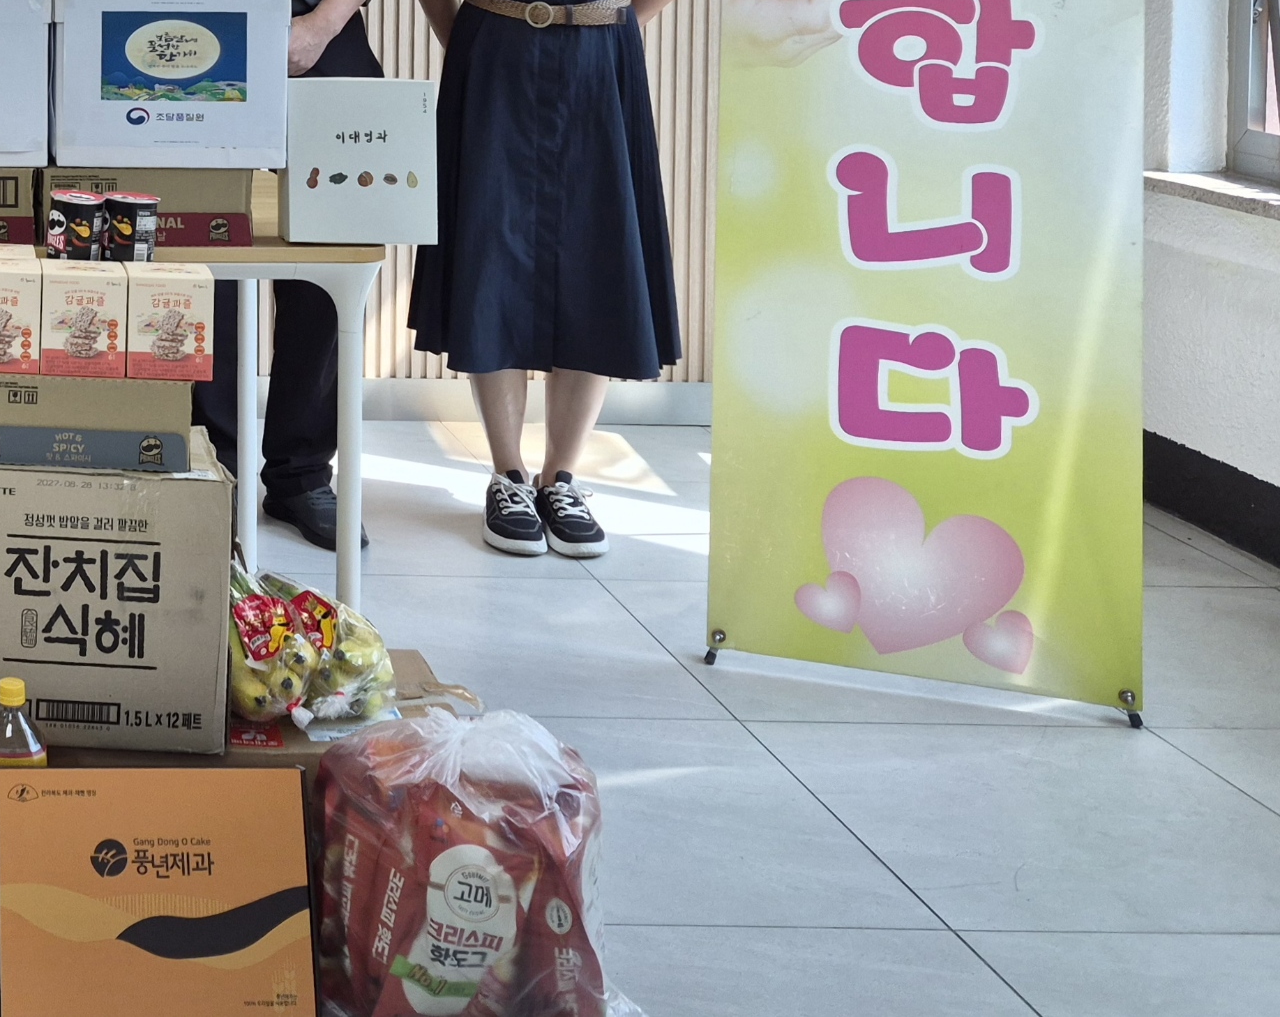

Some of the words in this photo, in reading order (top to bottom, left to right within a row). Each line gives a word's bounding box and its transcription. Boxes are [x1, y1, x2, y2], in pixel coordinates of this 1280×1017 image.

[155, 112, 205, 123] 조달품질원
[54, 432, 74, 441] HOT
[52, 443, 86, 452] SPICY
[23, 513, 56, 528] 정성껏
[58, 515, 90, 530] 밥알을
[93, 516, 114, 531] 걸러
[117, 518, 149, 533] 깔끔한
[4, 544, 161, 604] 잔치집
[41, 603, 145, 659] 식혜
[133, 837, 155, 847] Gang
[157, 837, 180, 847] Dong
[190, 837, 211, 846] Cake
[132, 849, 215, 879] 풍년제과
[453, 880, 492, 909] 고메
